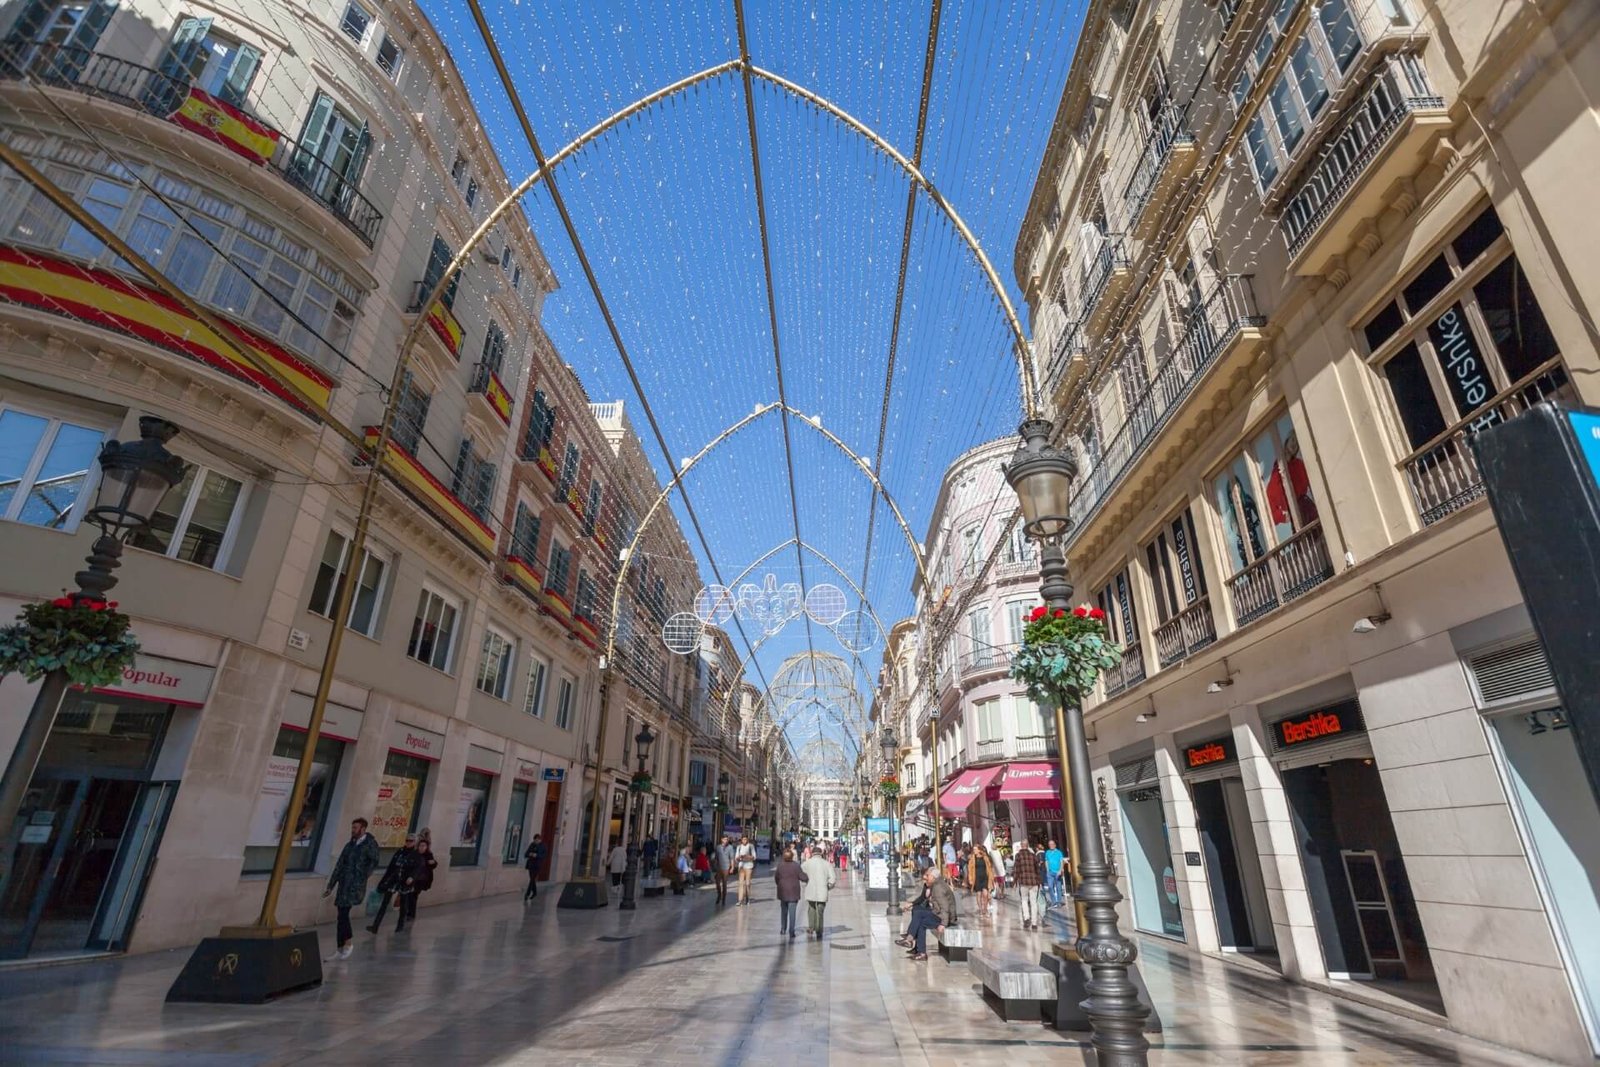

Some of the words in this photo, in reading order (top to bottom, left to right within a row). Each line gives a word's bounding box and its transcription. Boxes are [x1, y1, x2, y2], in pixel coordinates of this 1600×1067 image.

[1175, 530, 1196, 603] Bershka
[1119, 582, 1134, 645] Bershka
[406, 733, 430, 750] Popular
[1282, 712, 1342, 744] Bershka
[1188, 744, 1226, 767] Bershka
